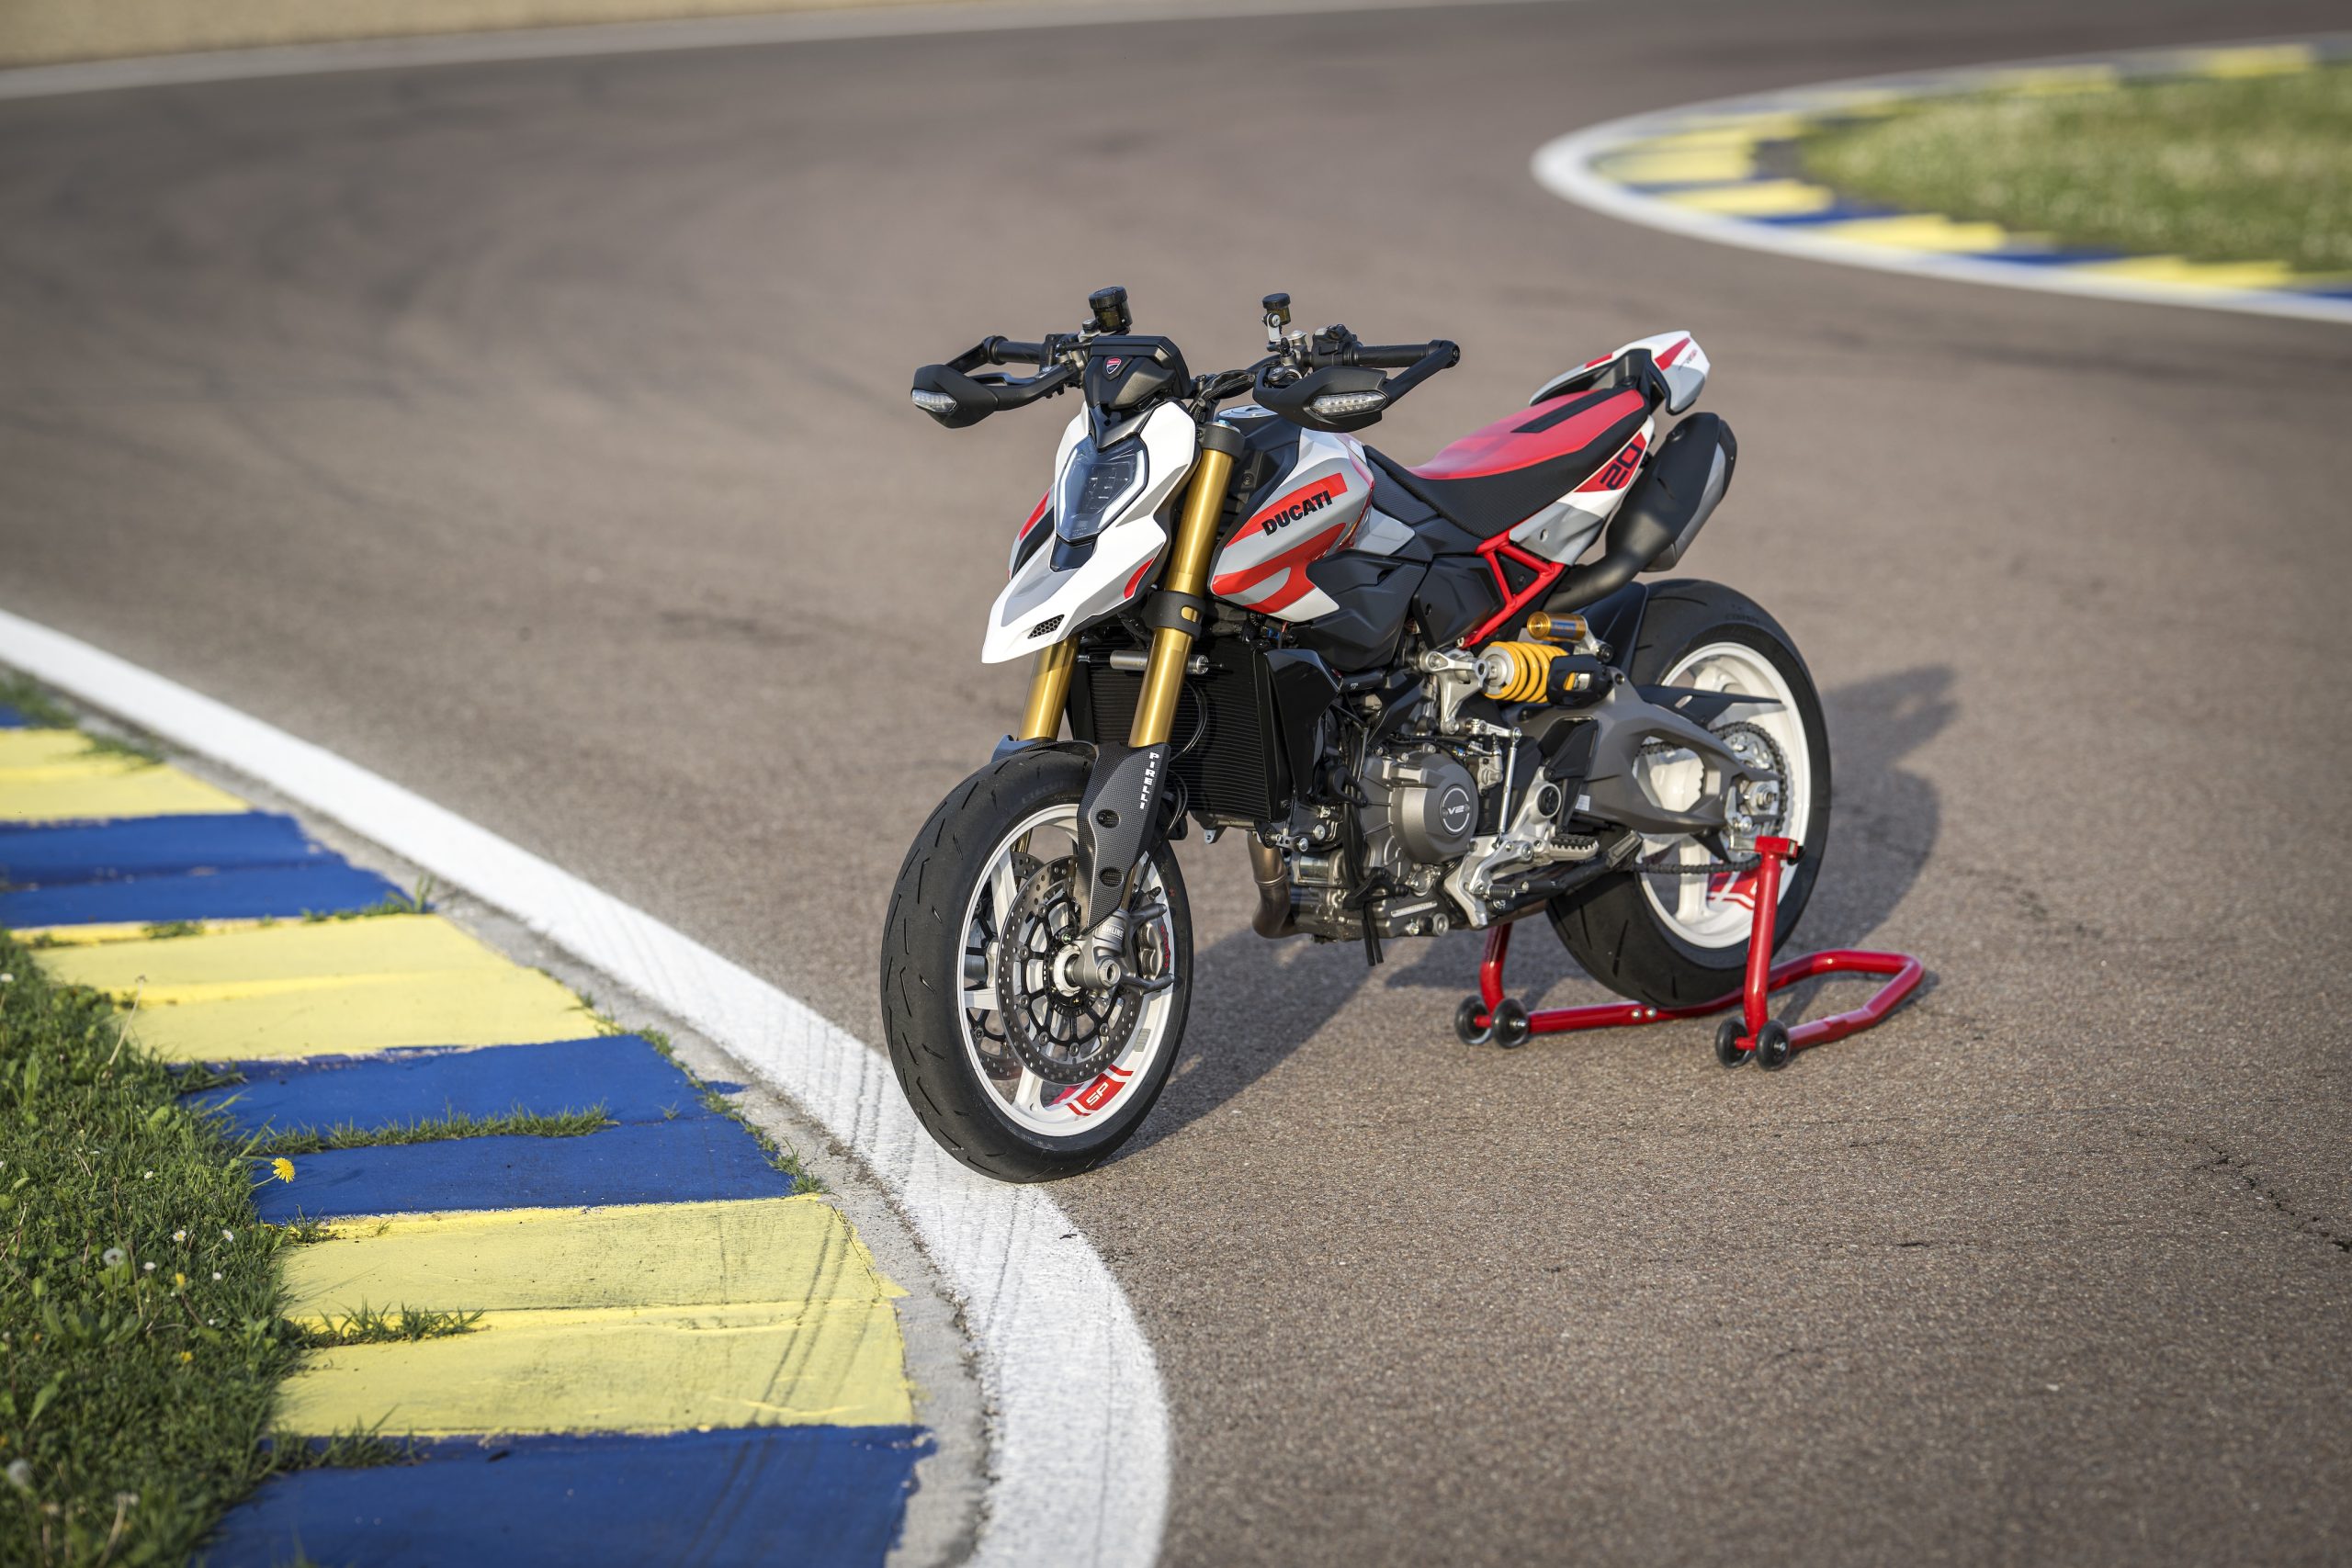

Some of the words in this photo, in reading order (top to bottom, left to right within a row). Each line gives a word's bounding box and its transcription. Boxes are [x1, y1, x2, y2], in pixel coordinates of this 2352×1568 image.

[1600, 442, 1643, 491] 20
[1261, 490, 1332, 536] DUCATI
[1139, 751, 1159, 809] PIRELLI
[1447, 805, 1464, 815] V2
[1085, 1081, 1109, 1106] SP
